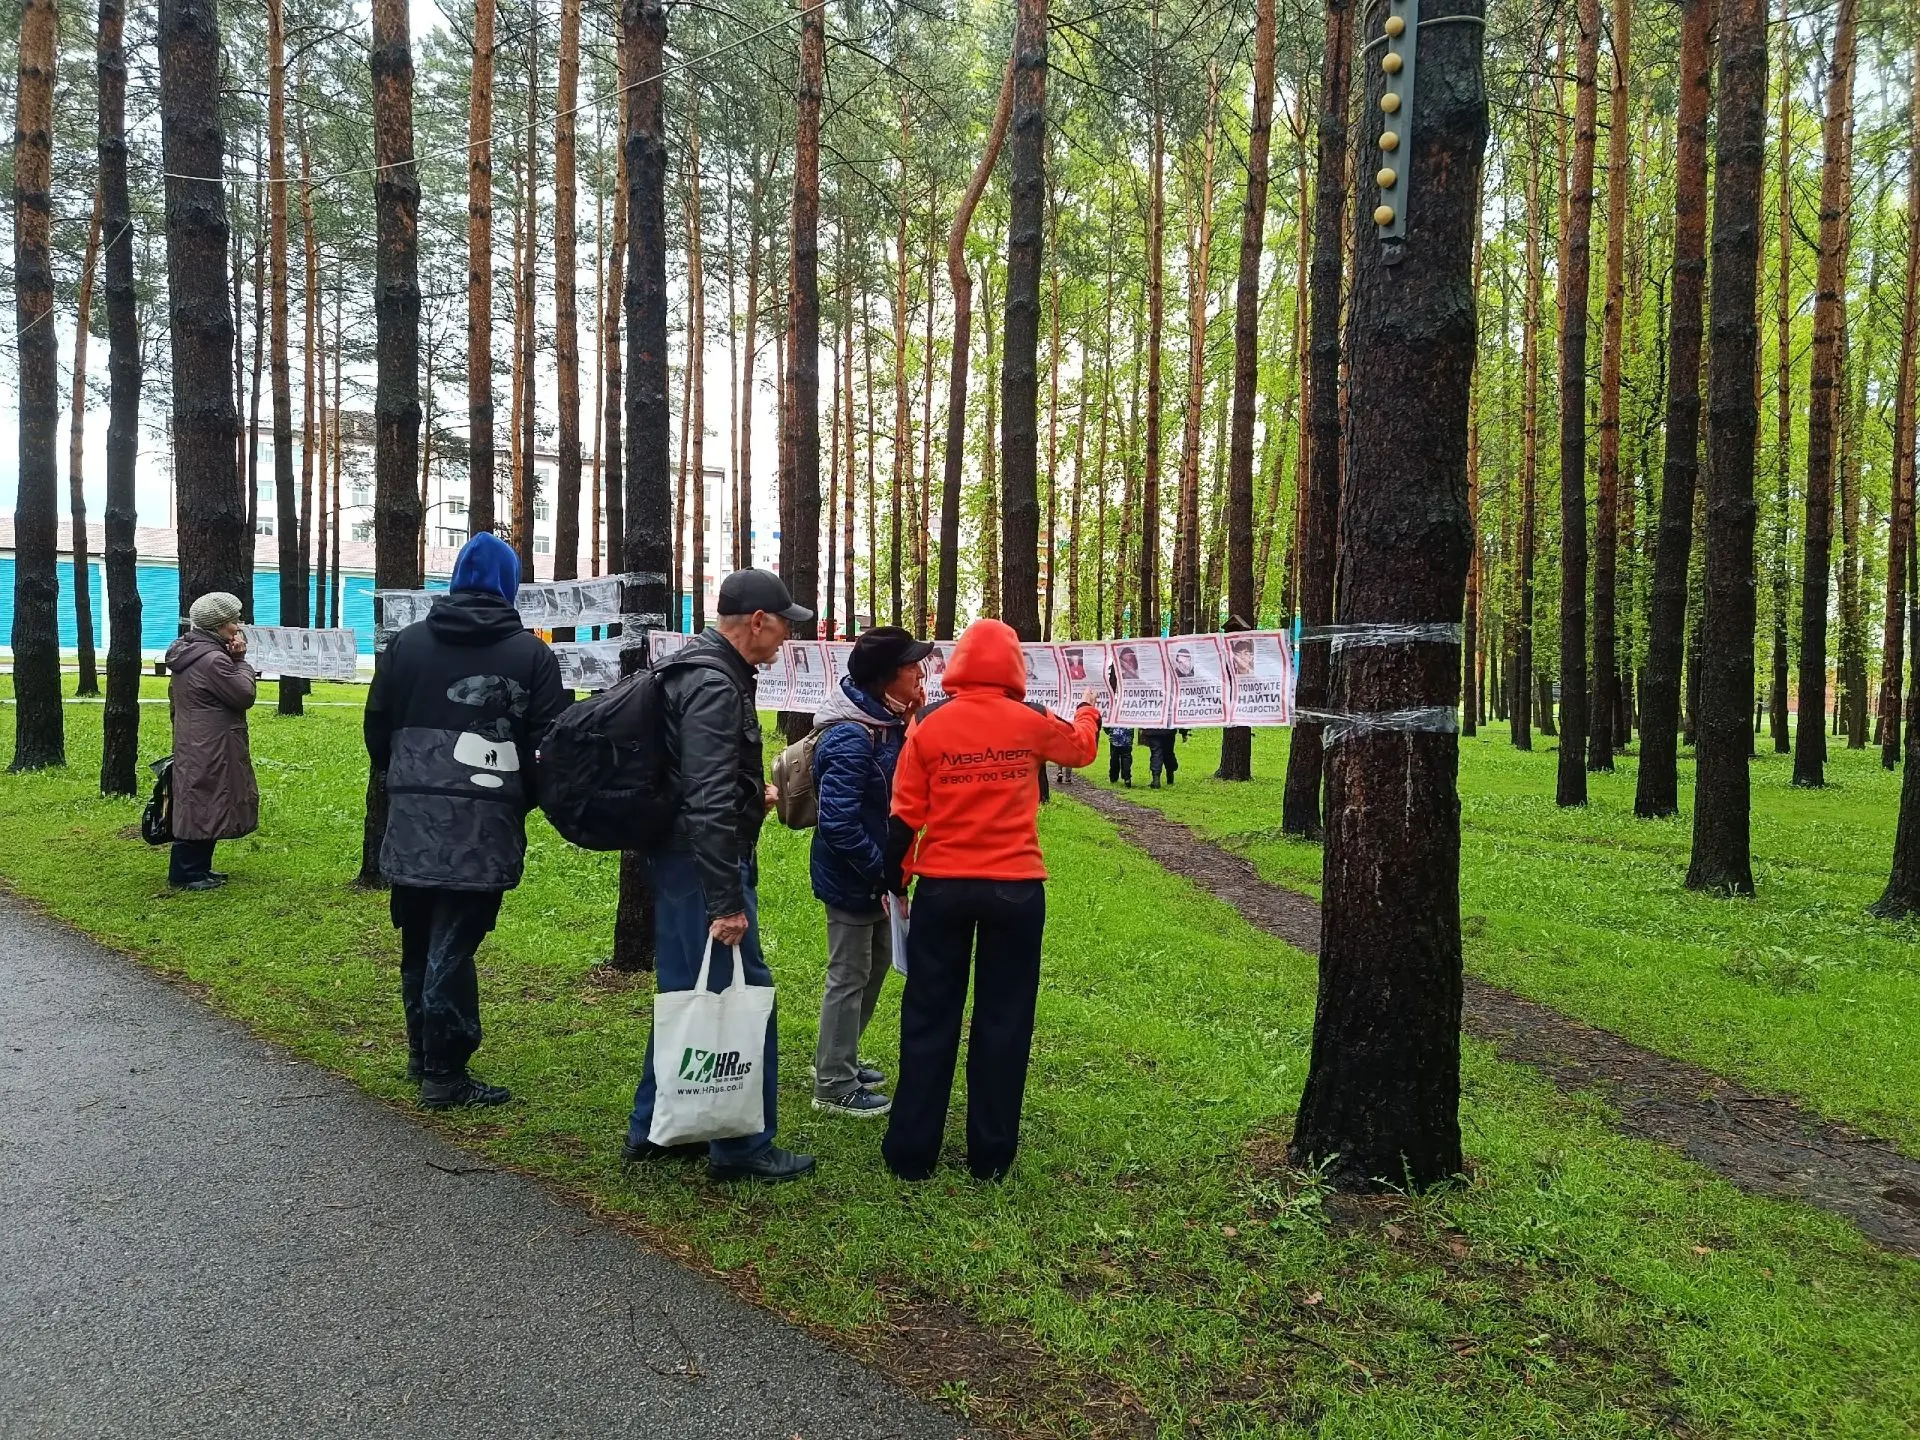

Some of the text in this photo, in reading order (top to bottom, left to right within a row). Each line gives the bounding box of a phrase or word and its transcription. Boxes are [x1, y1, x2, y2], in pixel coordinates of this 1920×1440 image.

[1179, 685, 1222, 696] ПОМОГИТЕ
[1237, 681, 1281, 692] ПОМОГИТЕ
[796, 688, 824, 697] НАЙТИ
[1026, 689, 1059, 698] ОМОГИТЕ
[1123, 689, 1164, 698] ПОМОГИТЕ
[1237, 691, 1281, 704] НАЙТИ
[1122, 697, 1164, 709] НАЙТИ
[1178, 694, 1222, 708] НАЙТИ
[1177, 707, 1223, 717] ПОДРОСТКА
[1235, 705, 1282, 713] ПОДРОСТКА
[941, 746, 1033, 767] ЛизаАлерт
[950, 774, 974, 785] 800
[976, 771, 998, 783] 700
[712, 1051, 753, 1079] HRus
